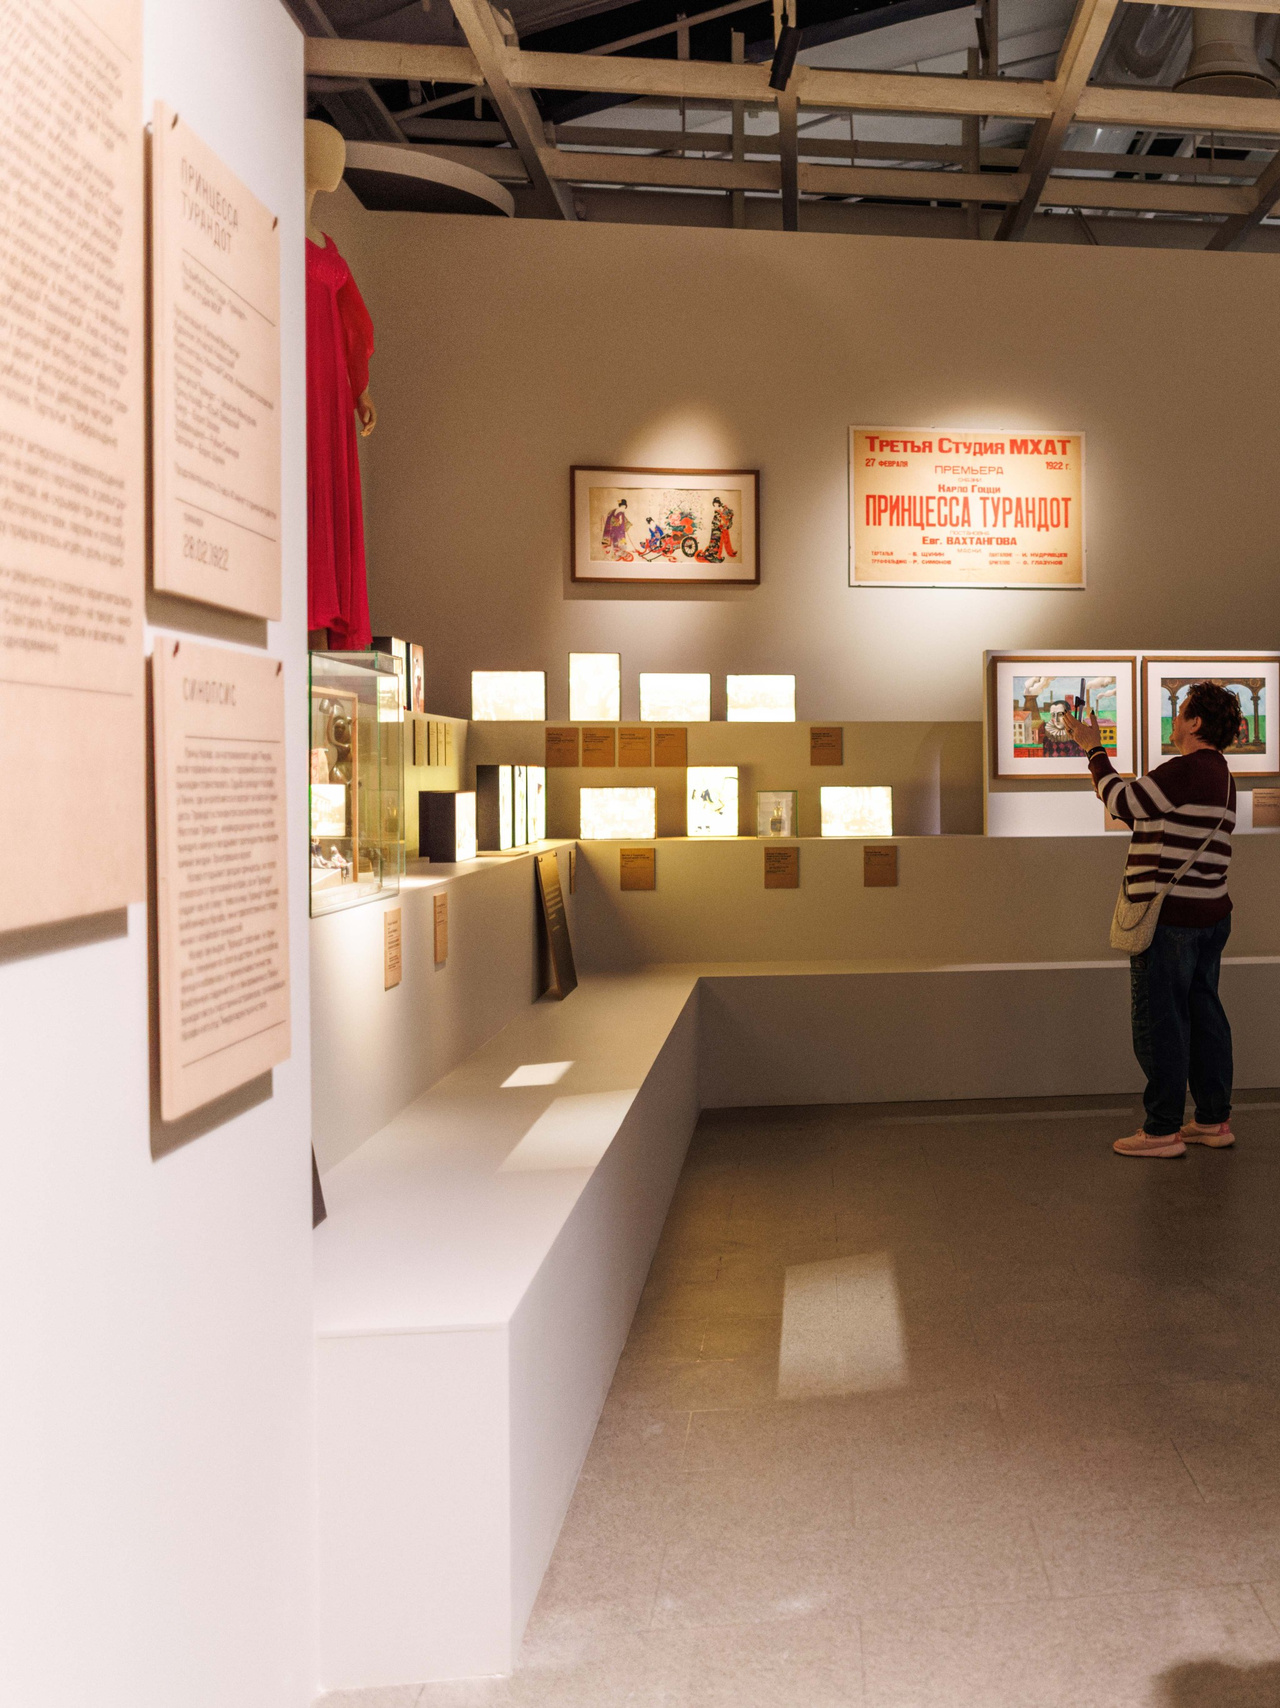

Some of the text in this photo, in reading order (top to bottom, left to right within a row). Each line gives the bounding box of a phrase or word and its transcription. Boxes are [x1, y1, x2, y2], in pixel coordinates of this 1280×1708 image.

[181, 156, 239, 231] ПРИНЦЕССА
[181, 190, 232, 254] ТУРАНДОТ
[1009, 438, 1071, 456] МХАТ
[865, 458, 876, 467] 27
[934, 465, 1004, 475] ПРЕМЬЕРА
[1045, 461, 1064, 470] 1922
[865, 494, 1072, 532] ПРИНЦЕССА ТУРАНДОТ
[946, 537, 1017, 546] ВАХТАНГОВА
[183, 676, 237, 707] СИНОПСИС
